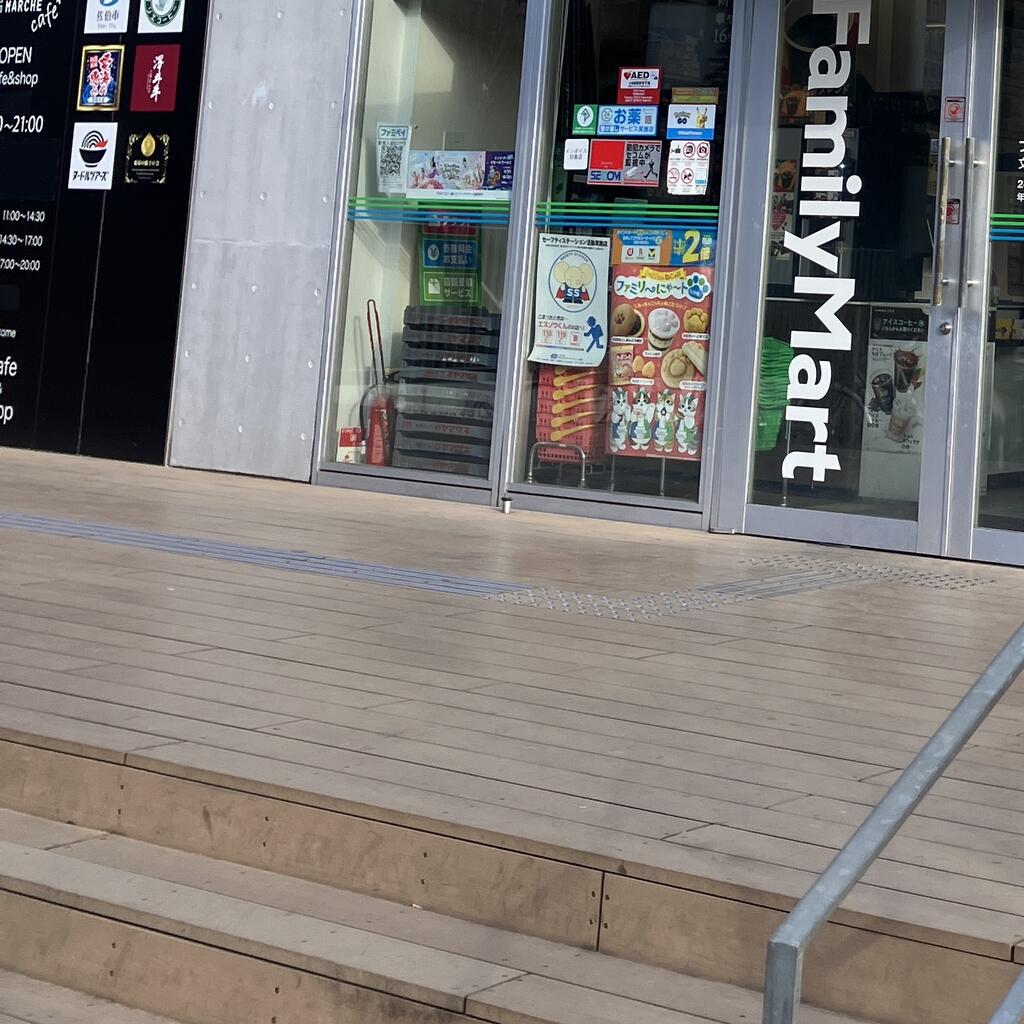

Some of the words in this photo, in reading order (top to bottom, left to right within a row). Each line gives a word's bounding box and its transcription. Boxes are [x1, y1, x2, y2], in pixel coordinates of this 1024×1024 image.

[0, 46, 33, 65] OPEN
[631, 71, 650, 79] AED
[614, 108, 642, 125] お薬
